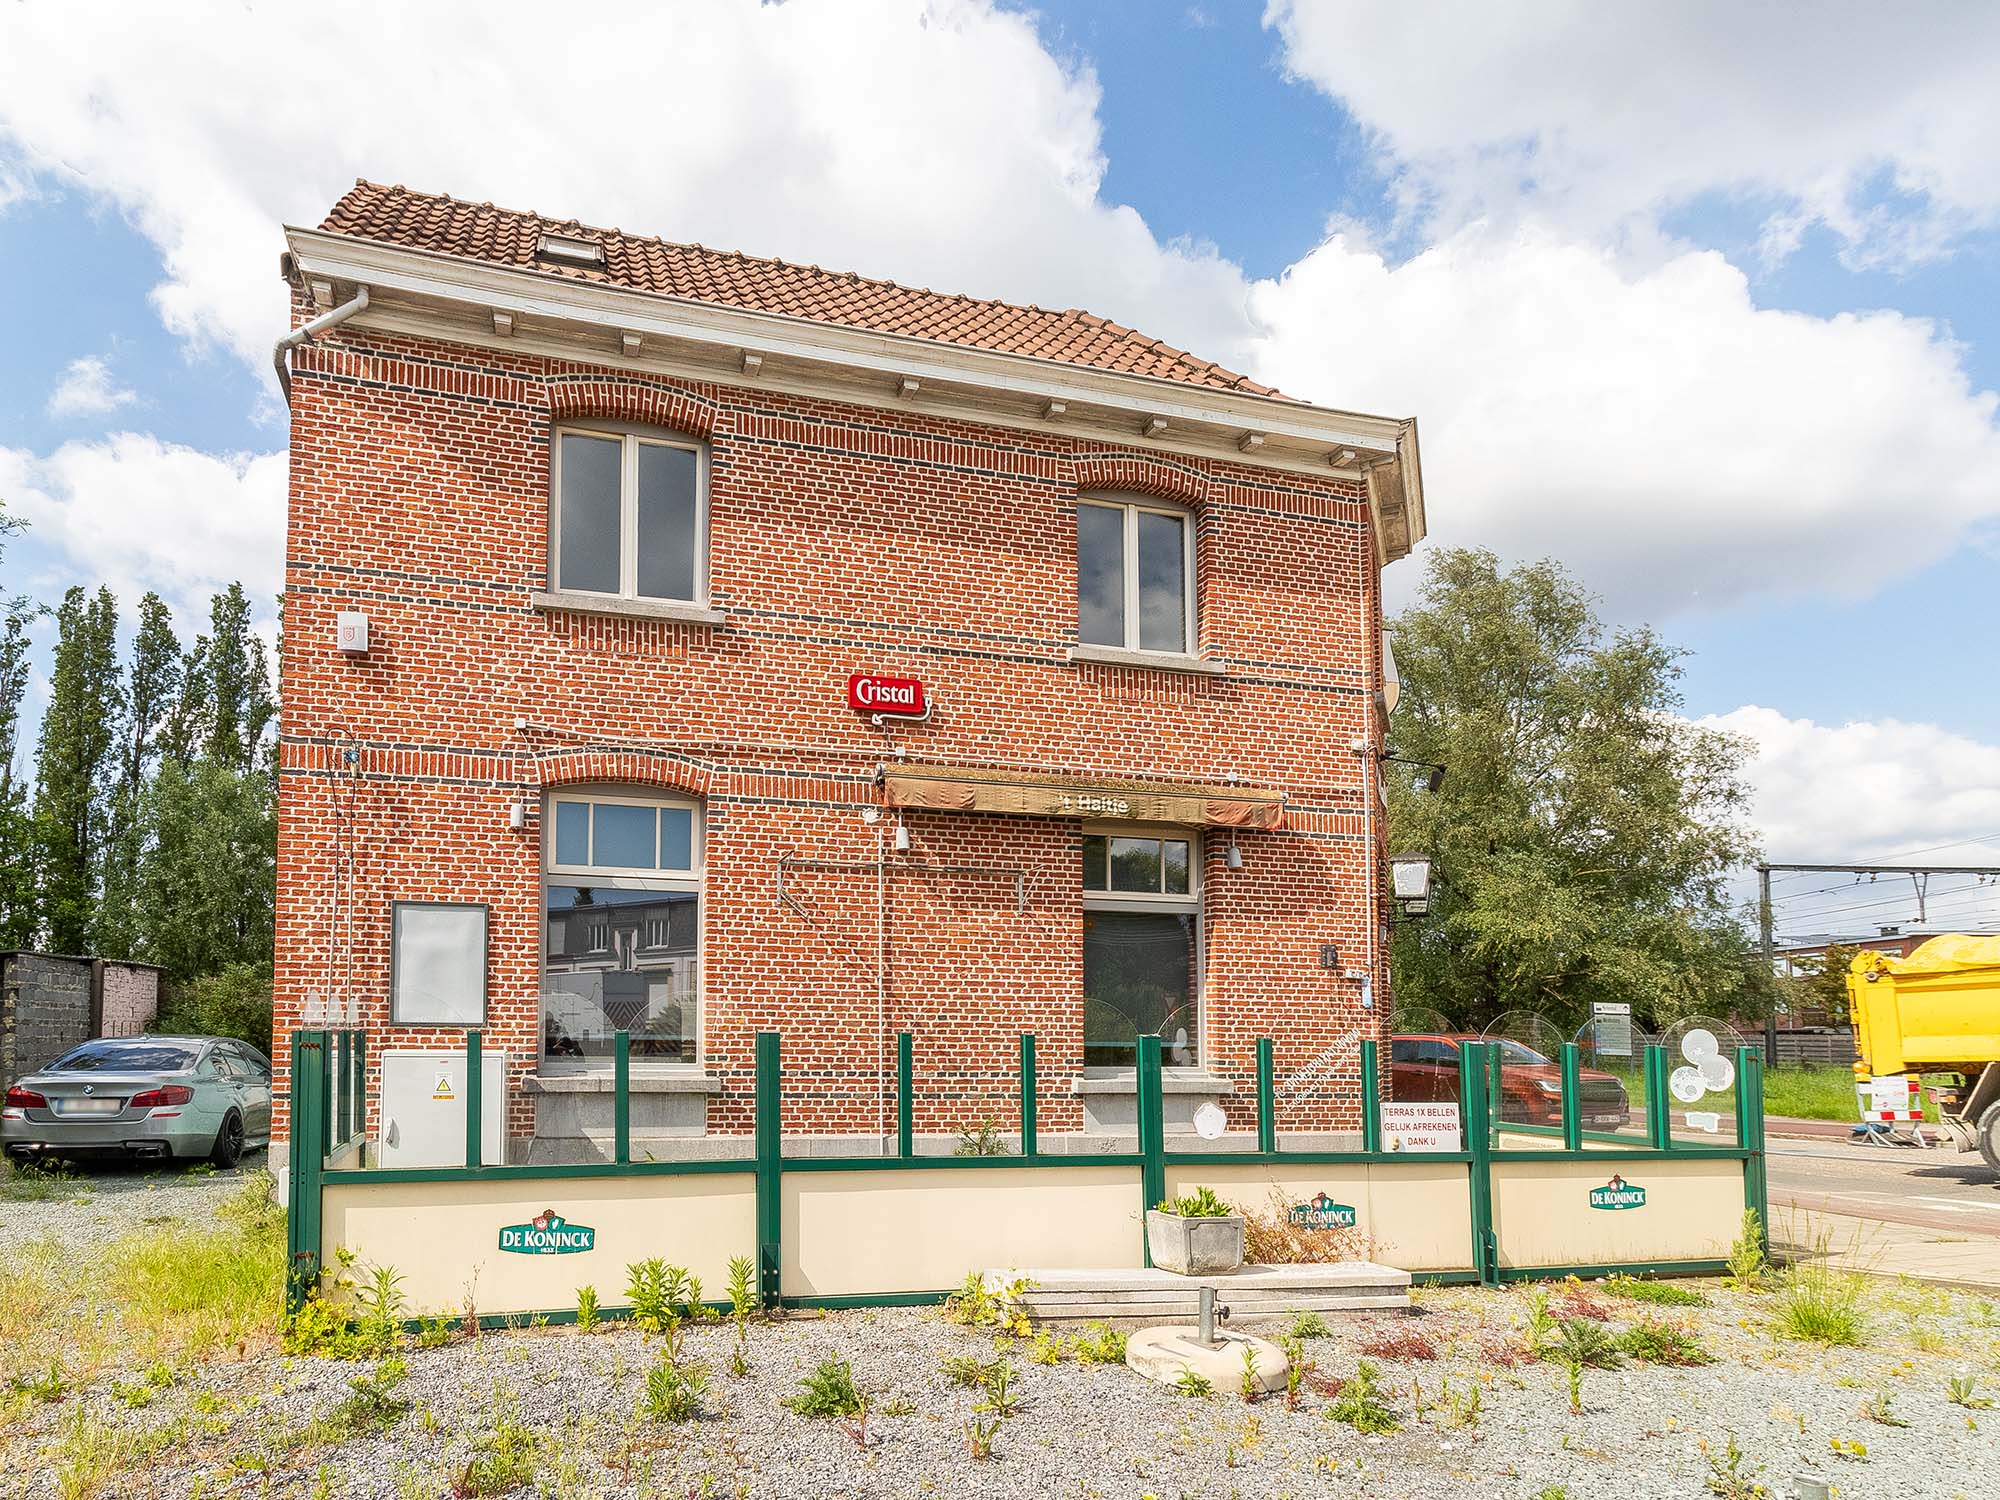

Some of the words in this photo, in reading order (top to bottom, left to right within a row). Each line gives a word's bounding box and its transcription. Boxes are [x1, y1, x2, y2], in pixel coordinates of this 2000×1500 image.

[856, 679, 915, 704] Cristal
[1384, 1108, 1415, 1117] TERRAS
[1416, 1108, 1426, 1117] 1X
[1427, 1108, 1456, 1117] BELLEN
[1384, 1122, 1412, 1131] GELIJK
[1412, 1122, 1457, 1131] AFREKENEN
[1407, 1137, 1429, 1146] DANK
[1430, 1137, 1437, 1146] U
[1591, 1192, 1604, 1205] DE
[1604, 1191, 1645, 1205] KONINCK
[502, 1230, 522, 1247] DE
[524, 1230, 590, 1247] KONINCK
